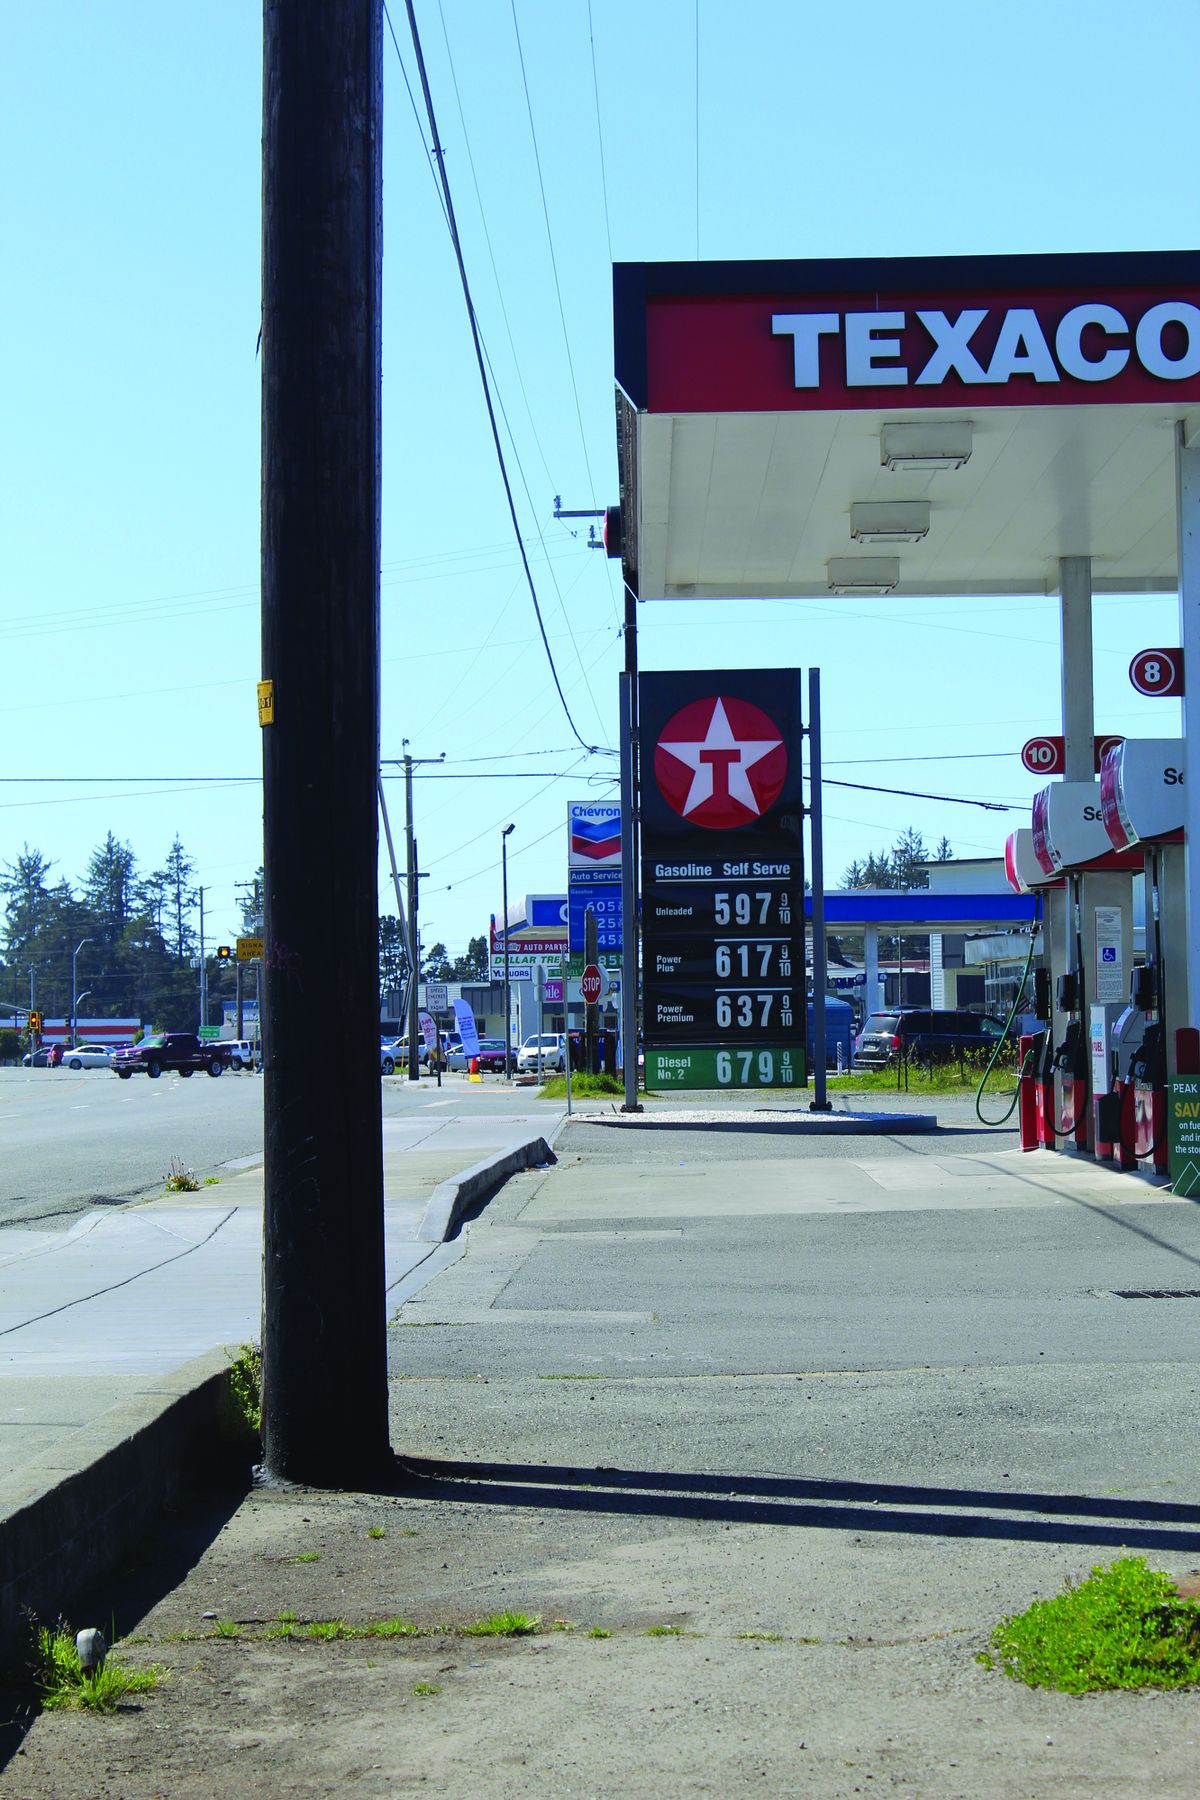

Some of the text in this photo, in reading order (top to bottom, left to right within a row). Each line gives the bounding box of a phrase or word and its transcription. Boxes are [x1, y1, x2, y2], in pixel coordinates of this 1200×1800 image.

[771, 302, 1200, 388] TEXACO
[1144, 661, 1161, 683] 8
[1028, 746, 1052, 764] 10
[572, 806, 621, 817] Chevron
[655, 862, 791, 877] Gasoline Self Serve
[586, 901, 616, 912] 605
[655, 892, 772, 925] Unleaded 597
[597, 918, 616, 929] 25
[597, 934, 617, 945] 45
[523, 943, 542, 951] AUTO
[545, 943, 567, 951] PARTS
[540, 955, 566, 964] TRE
[598, 955, 617, 966] 85
[656, 955, 682, 964] Power
[715, 945, 773, 977] 617
[656, 964, 675, 973] Plus
[583, 977, 601, 992] STOP
[657, 1005, 683, 1013] Power
[716, 995, 773, 1028] 637
[657, 1014, 694, 1022] Premium
[657, 1056, 691, 1068] Diesel
[716, 1051, 774, 1084] 679
[677, 1069, 685, 1080] 2
[1173, 1083, 1198, 1093] PEAK
[1181, 1133, 1194, 1142] and
[1175, 1145, 1187, 1153] the
